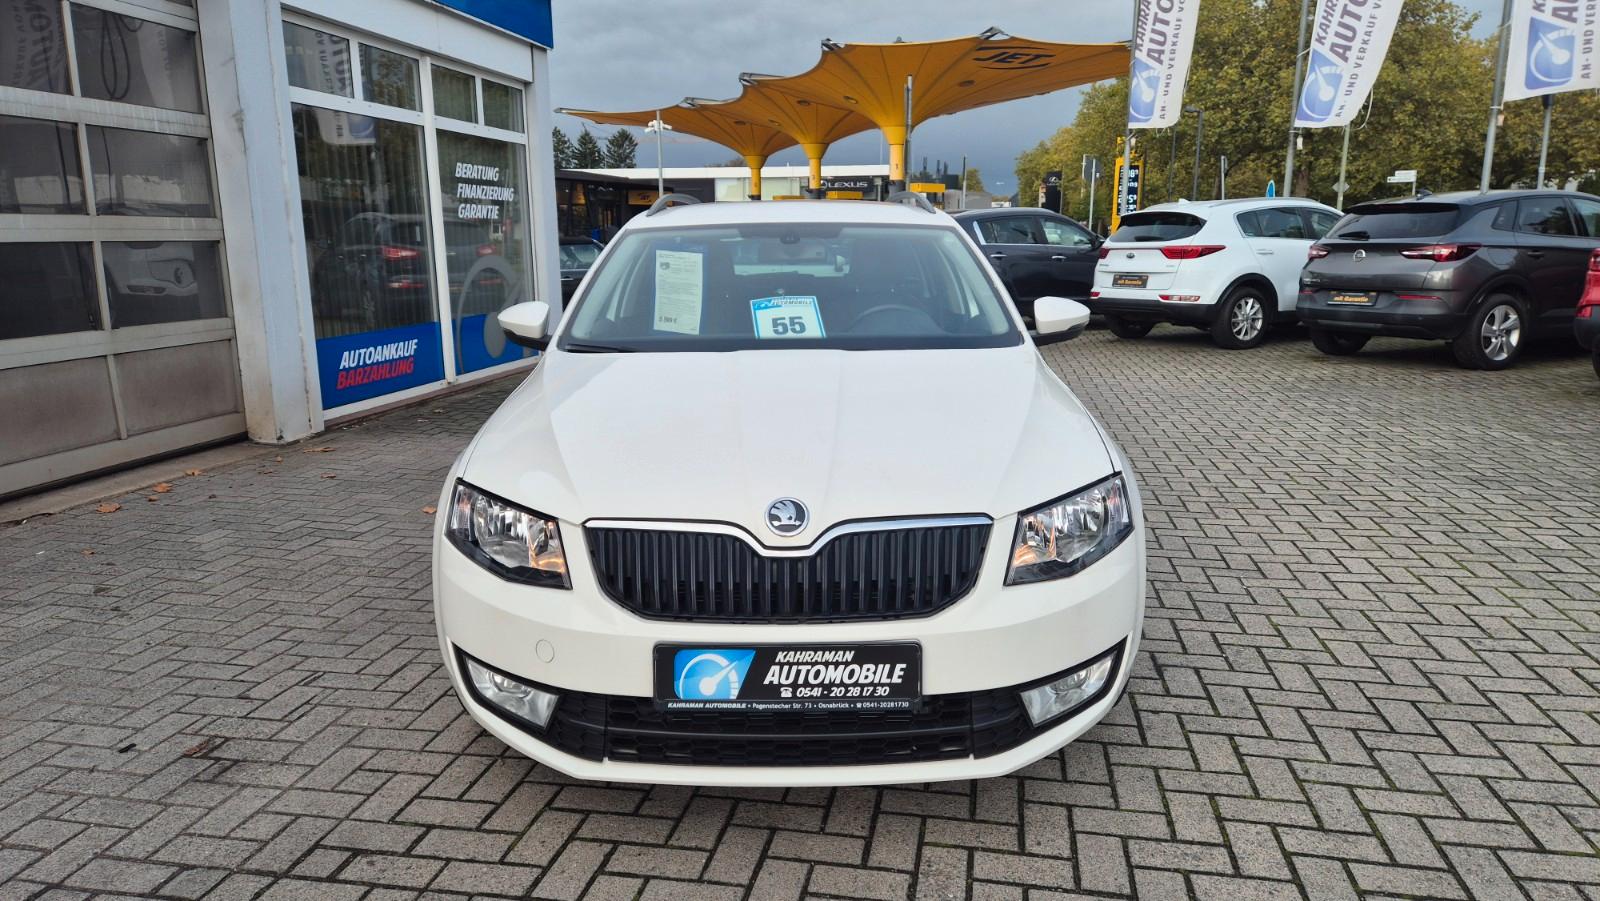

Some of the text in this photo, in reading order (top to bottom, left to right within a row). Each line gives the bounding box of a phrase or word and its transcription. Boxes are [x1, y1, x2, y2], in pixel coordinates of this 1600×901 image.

[1582, 29, 1594, 55] UND
[973, 51, 1057, 64] JET
[1163, 74, 1173, 97] UND
[1168, 17, 1183, 71] VERKAUF
[1344, 73, 1359, 96] UND
[1355, 13, 1378, 68] VERKAUF
[455, 162, 499, 181] BERATUNG
[456, 183, 514, 202] FINANZIERUNG
[458, 203, 500, 220] GARANTIE
[772, 316, 806, 335] 55
[339, 339, 418, 370] AUTOANKAUF
[336, 357, 415, 390] BARZAHLUNG
[775, 650, 855, 663] KAHRAMAN
[763, 663, 907, 685] AUTOMOBILE
[796, 686, 822, 697] 0541
[829, 686, 845, 697] 20
[845, 686, 862, 697] 28
[862, 686, 874, 697] 17
[873, 686, 890, 697] 30
[752, 702, 791, 710] Pagenstecher
[818, 701, 849, 709] Osnabrück
